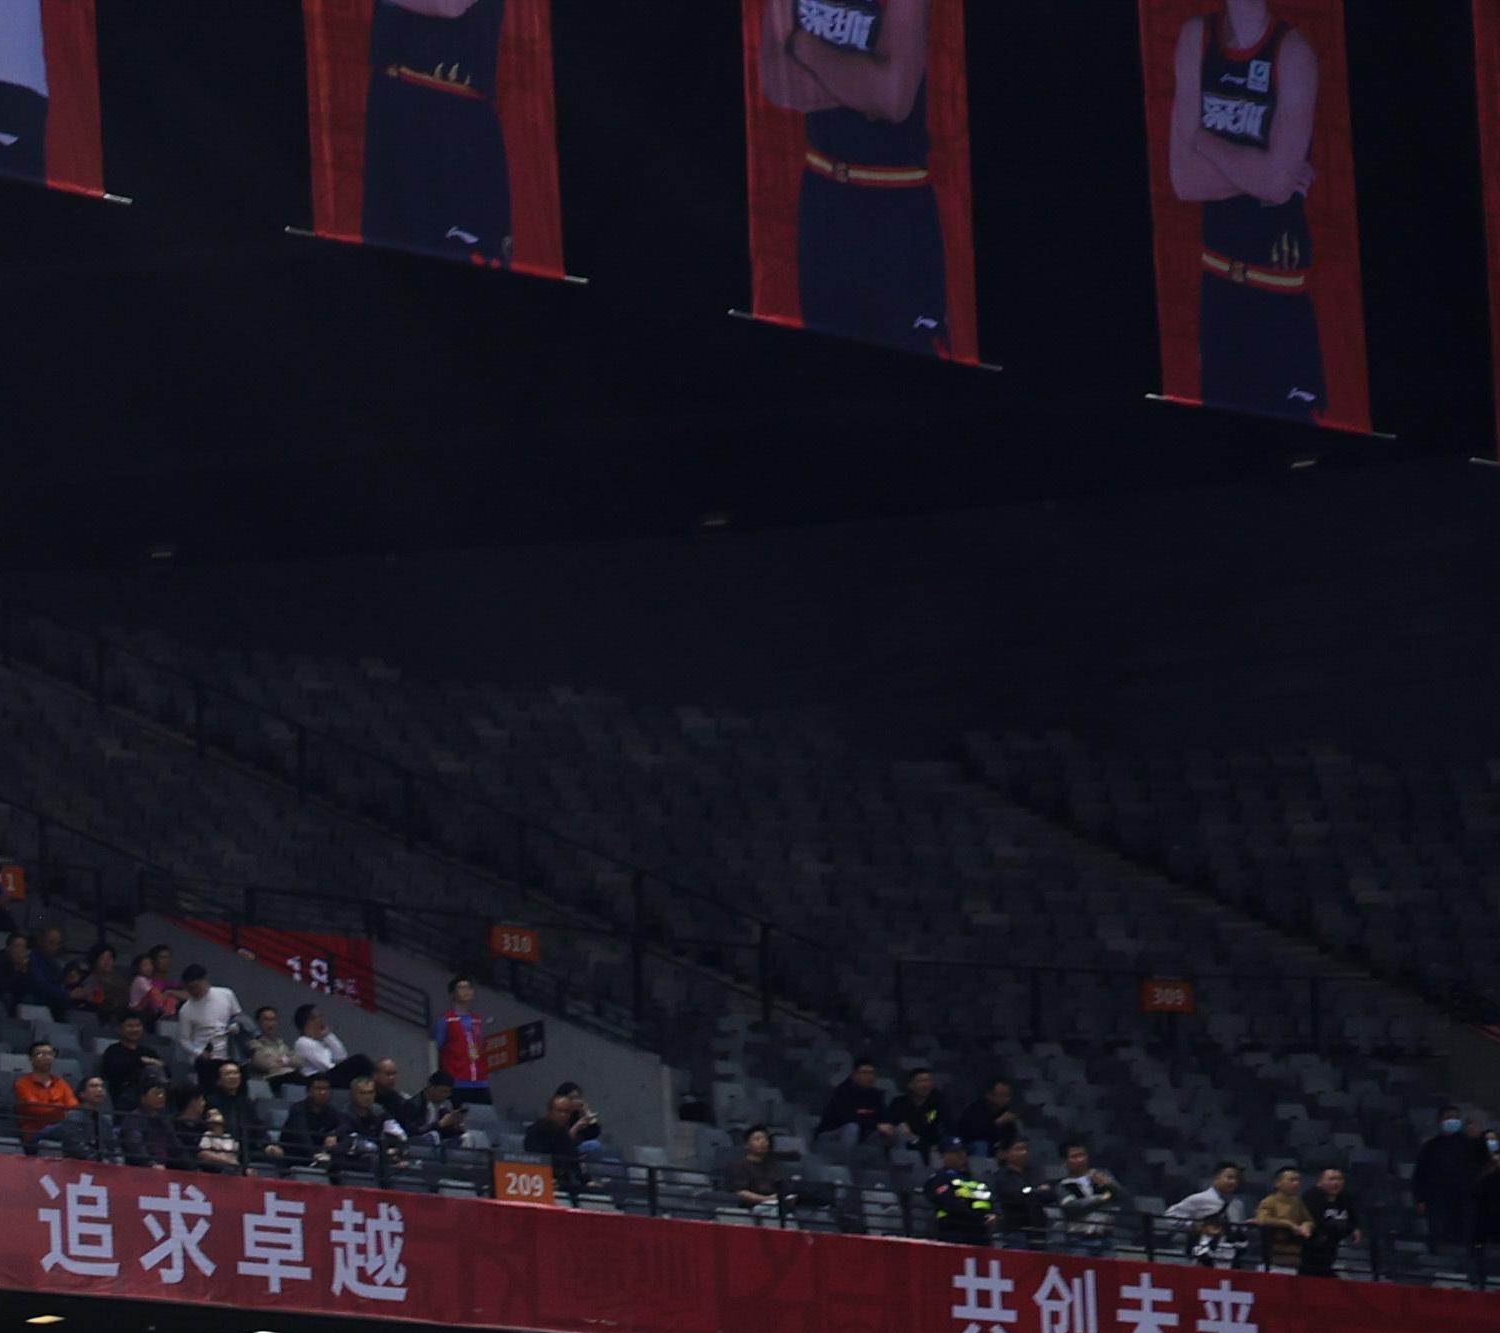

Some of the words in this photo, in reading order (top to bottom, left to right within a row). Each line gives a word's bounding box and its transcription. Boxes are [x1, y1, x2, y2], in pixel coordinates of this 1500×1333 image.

[505, 1172, 544, 1197] 209
[38, 1173, 409, 1302] 追求卓越
